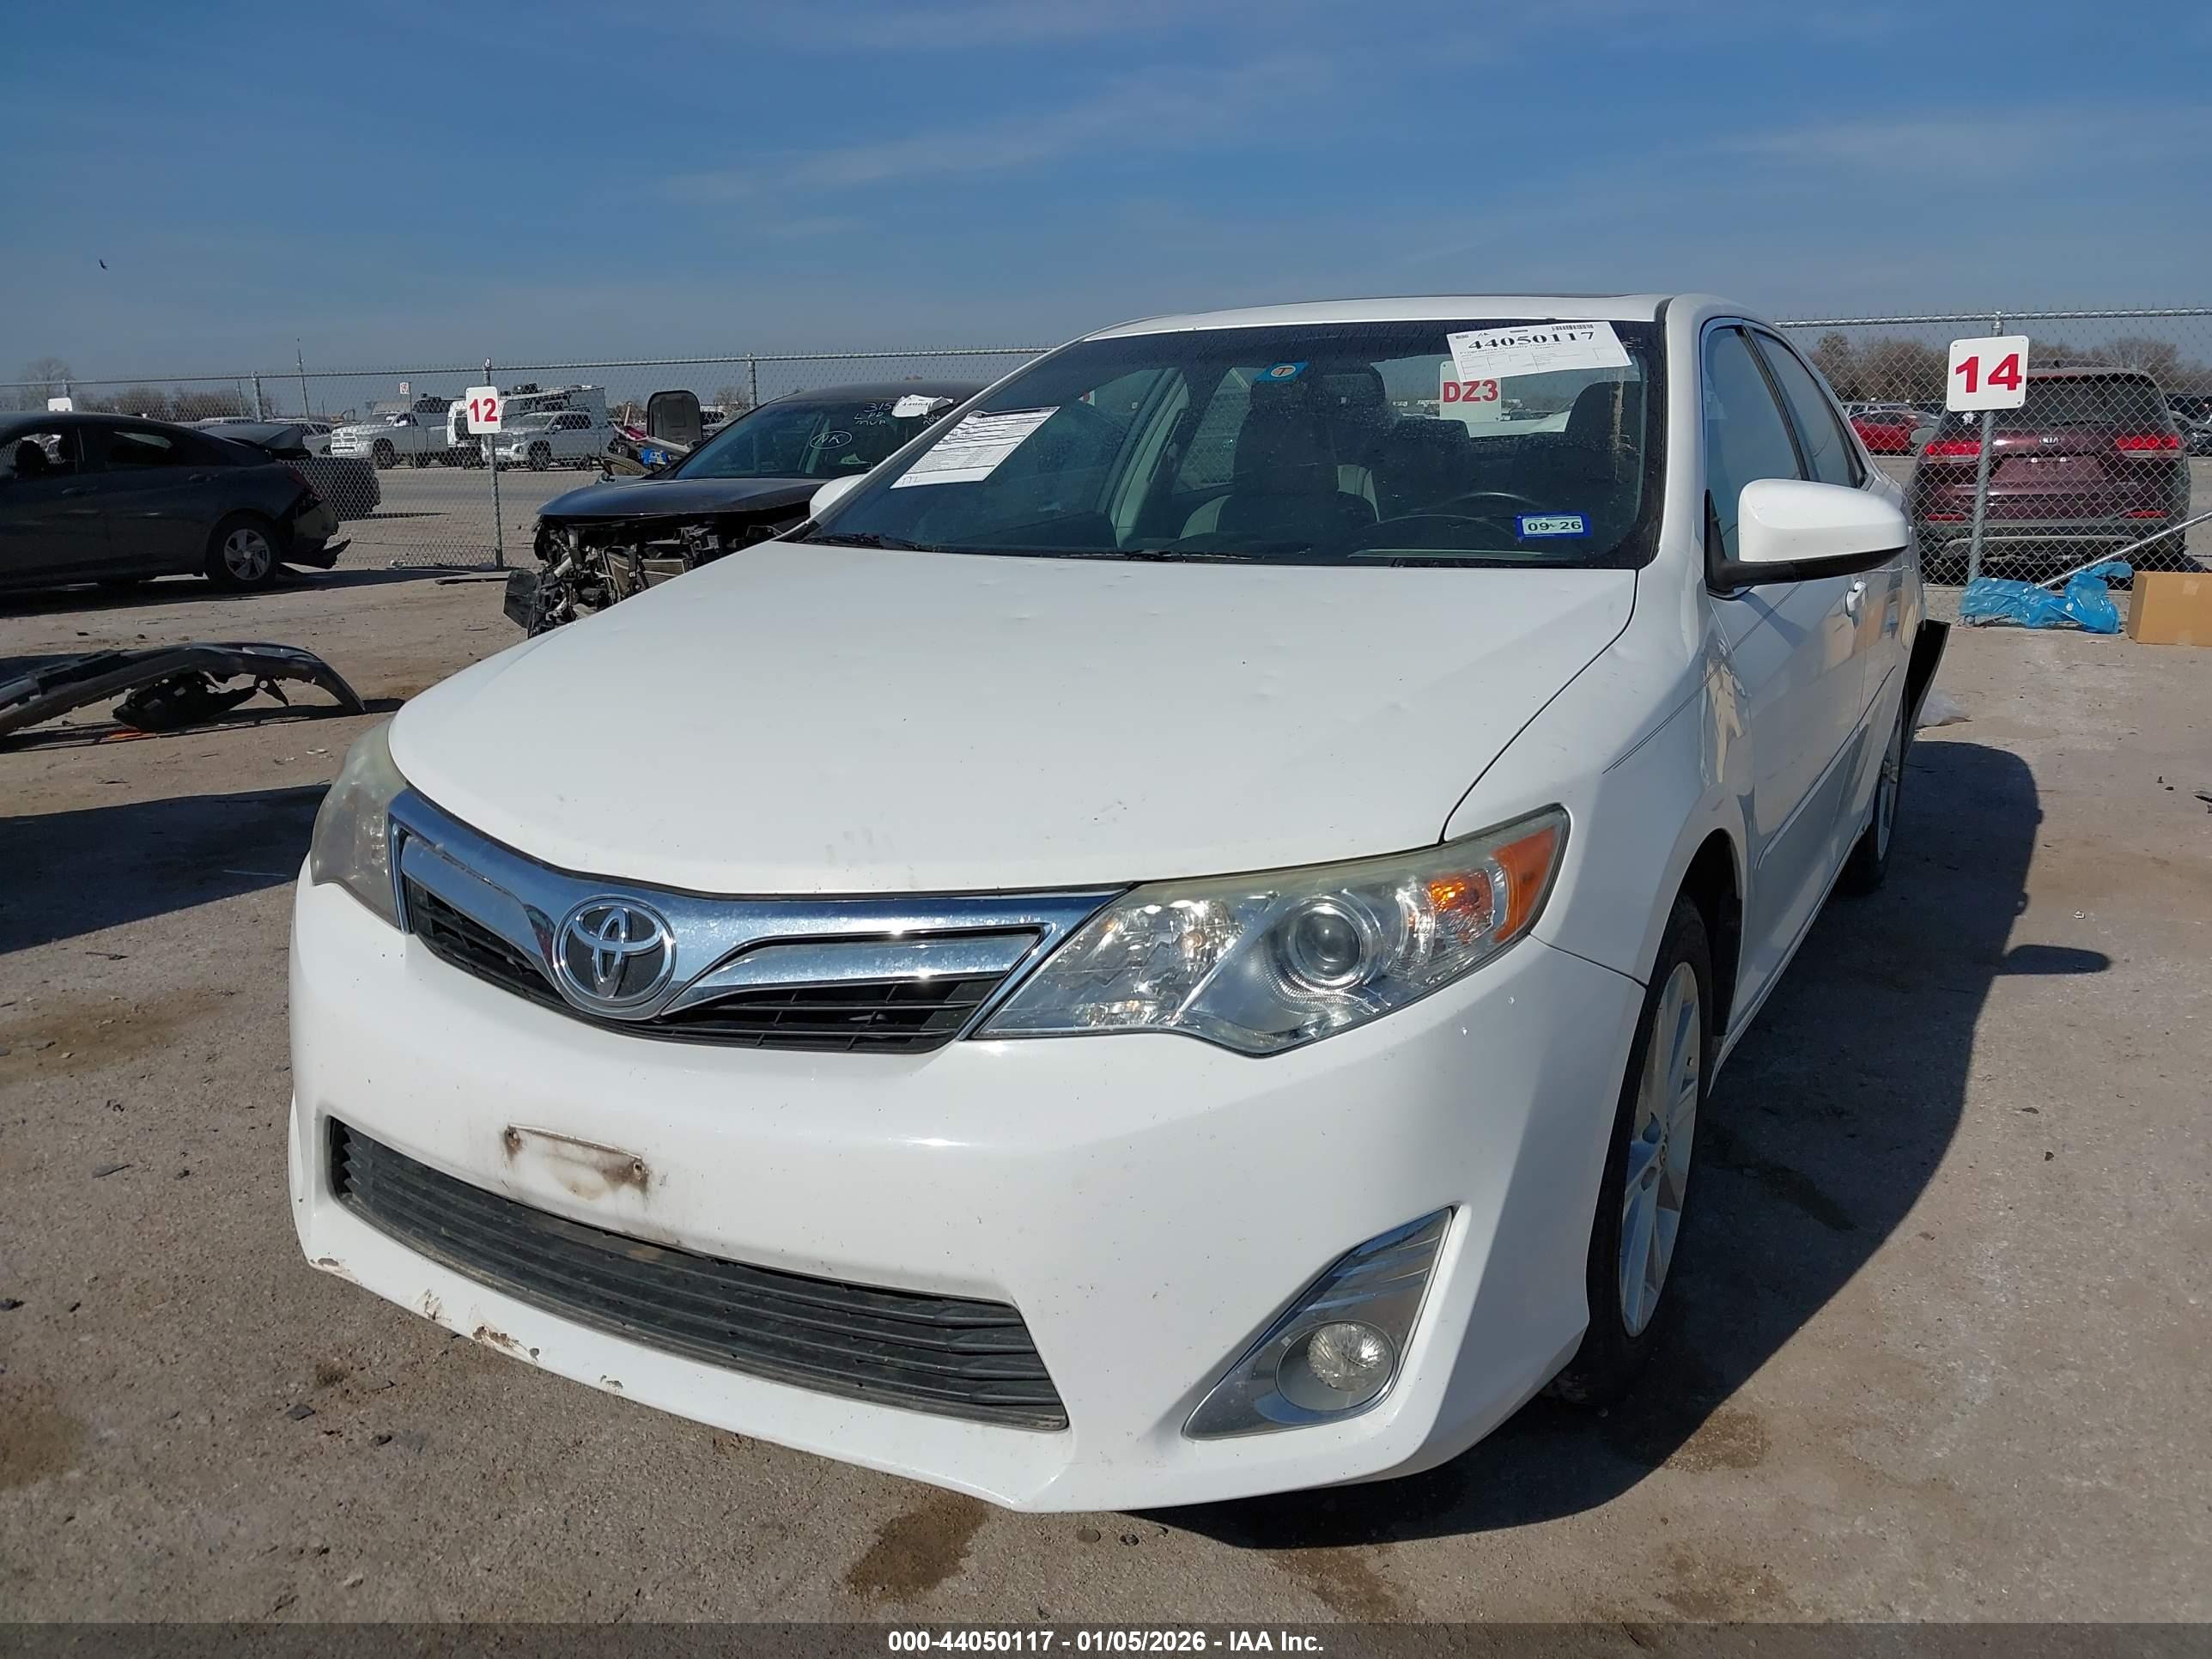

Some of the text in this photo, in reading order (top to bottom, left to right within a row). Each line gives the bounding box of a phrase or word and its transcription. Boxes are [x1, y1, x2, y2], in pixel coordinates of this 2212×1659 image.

[1468, 331, 1595, 350] 44050117
[1954, 353, 2023, 394] 14
[1443, 380, 1498, 404] DZ3
[469, 398, 498, 422] 12
